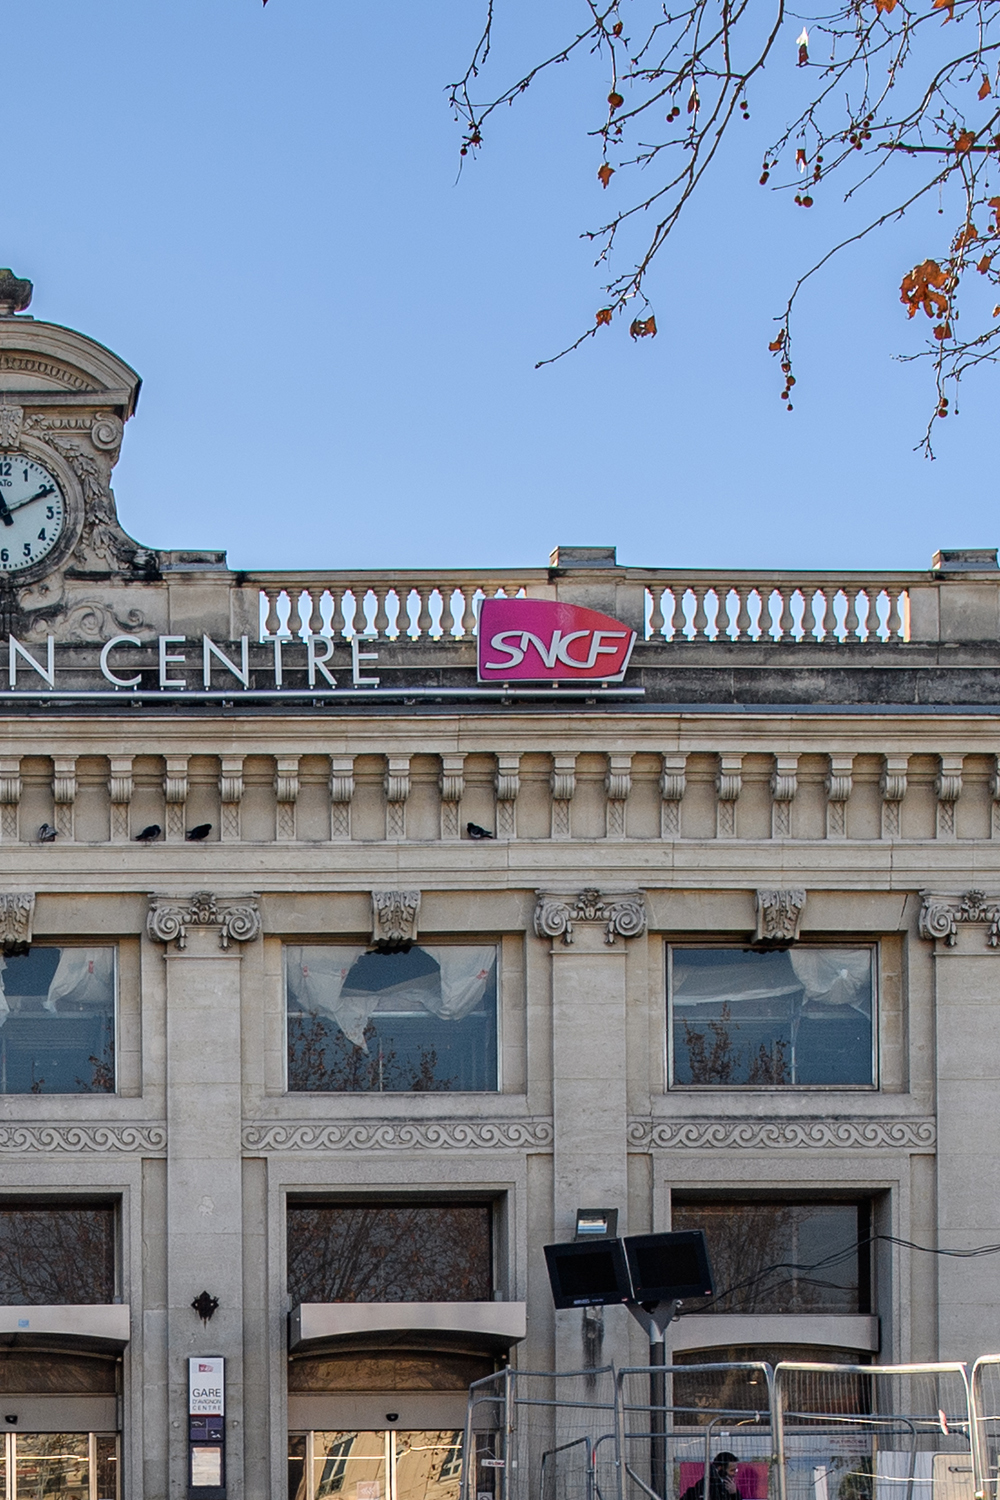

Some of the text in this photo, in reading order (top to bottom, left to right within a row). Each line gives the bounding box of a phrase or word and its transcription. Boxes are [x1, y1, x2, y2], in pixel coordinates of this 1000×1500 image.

[23, 469, 28, 482] 1
[46, 506, 55, 520] 3
[37, 527, 47, 541] 4
[0, 548, 10, 562] 6
[22, 543, 32, 557] 5
[484, 629, 628, 669] SNCF
[100, 635, 381, 688] CENTRE
[192, 1388, 222, 1398] GARE
